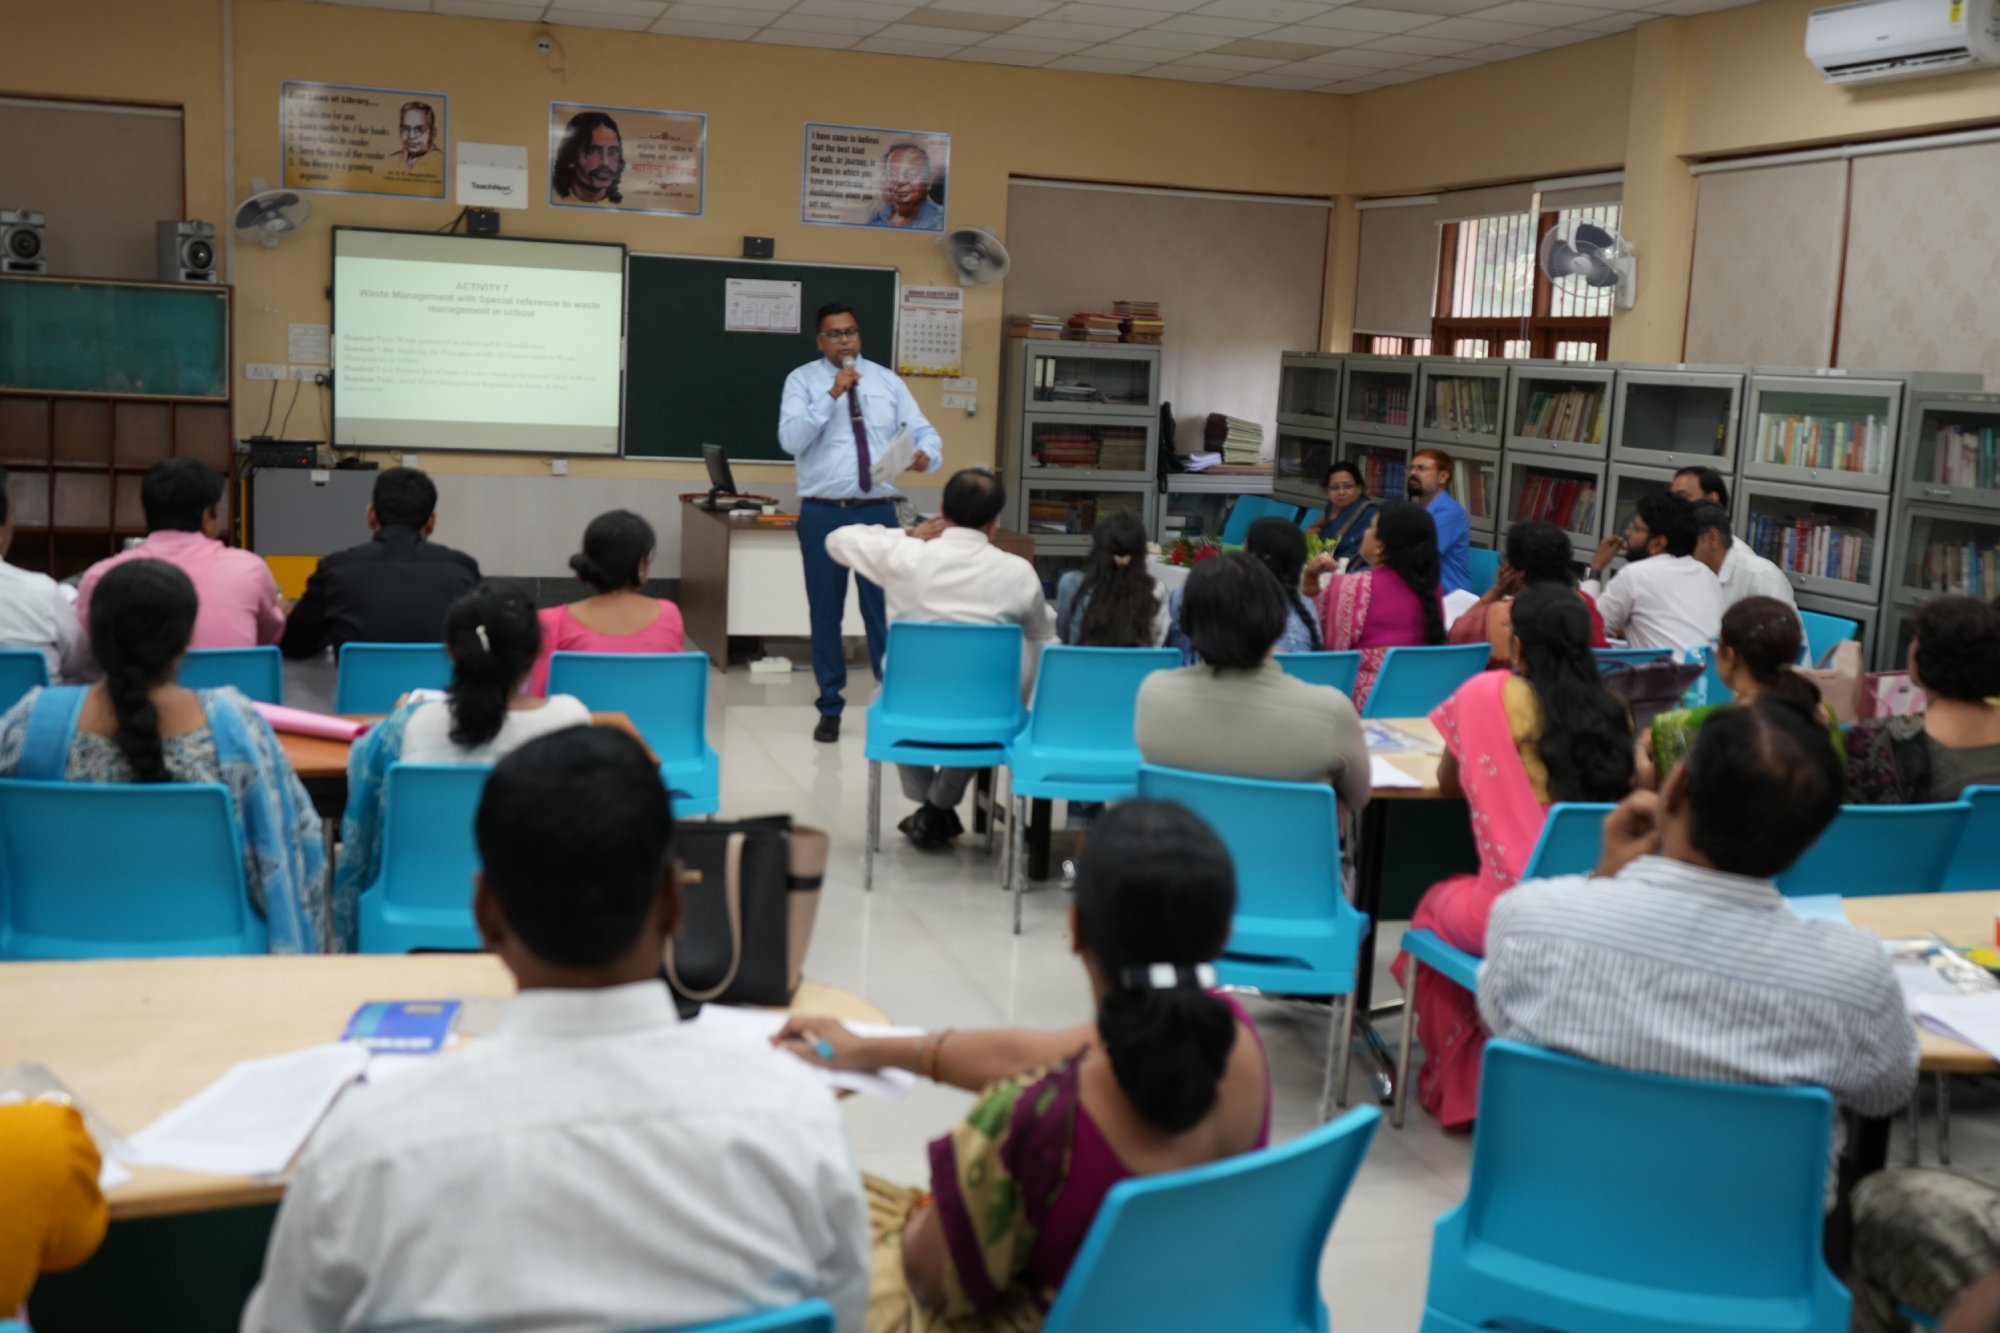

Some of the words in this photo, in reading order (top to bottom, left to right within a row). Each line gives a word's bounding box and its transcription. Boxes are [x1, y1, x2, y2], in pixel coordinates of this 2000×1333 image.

[816, 131, 831, 140] have
[858, 135, 879, 144] believe
[811, 143, 824, 151] that
[825, 143, 835, 152] the
[837, 145, 850, 153] best
[852, 146, 865, 154] kind
[811, 154, 817, 162] of
[811, 165, 820, 173] the
[843, 168, 859, 176] which
[862, 170, 872, 178] you
[810, 176, 824, 185] have
[845, 191, 861, 199] when
[862, 193, 873, 201] you
[456, 281, 501, 292] ACTIVITY
[503, 283, 509, 293] 7
[359, 287, 389, 299] Waste
[391, 289, 454, 302] Management
[456, 293, 477, 302] with
[479, 294, 514, 305] Special
[516, 297, 560, 307] reference
[562, 299, 571, 308] to
[574, 301, 600, 310] waste
[427, 304, 490, 316] management
[503, 308, 535, 318] school
